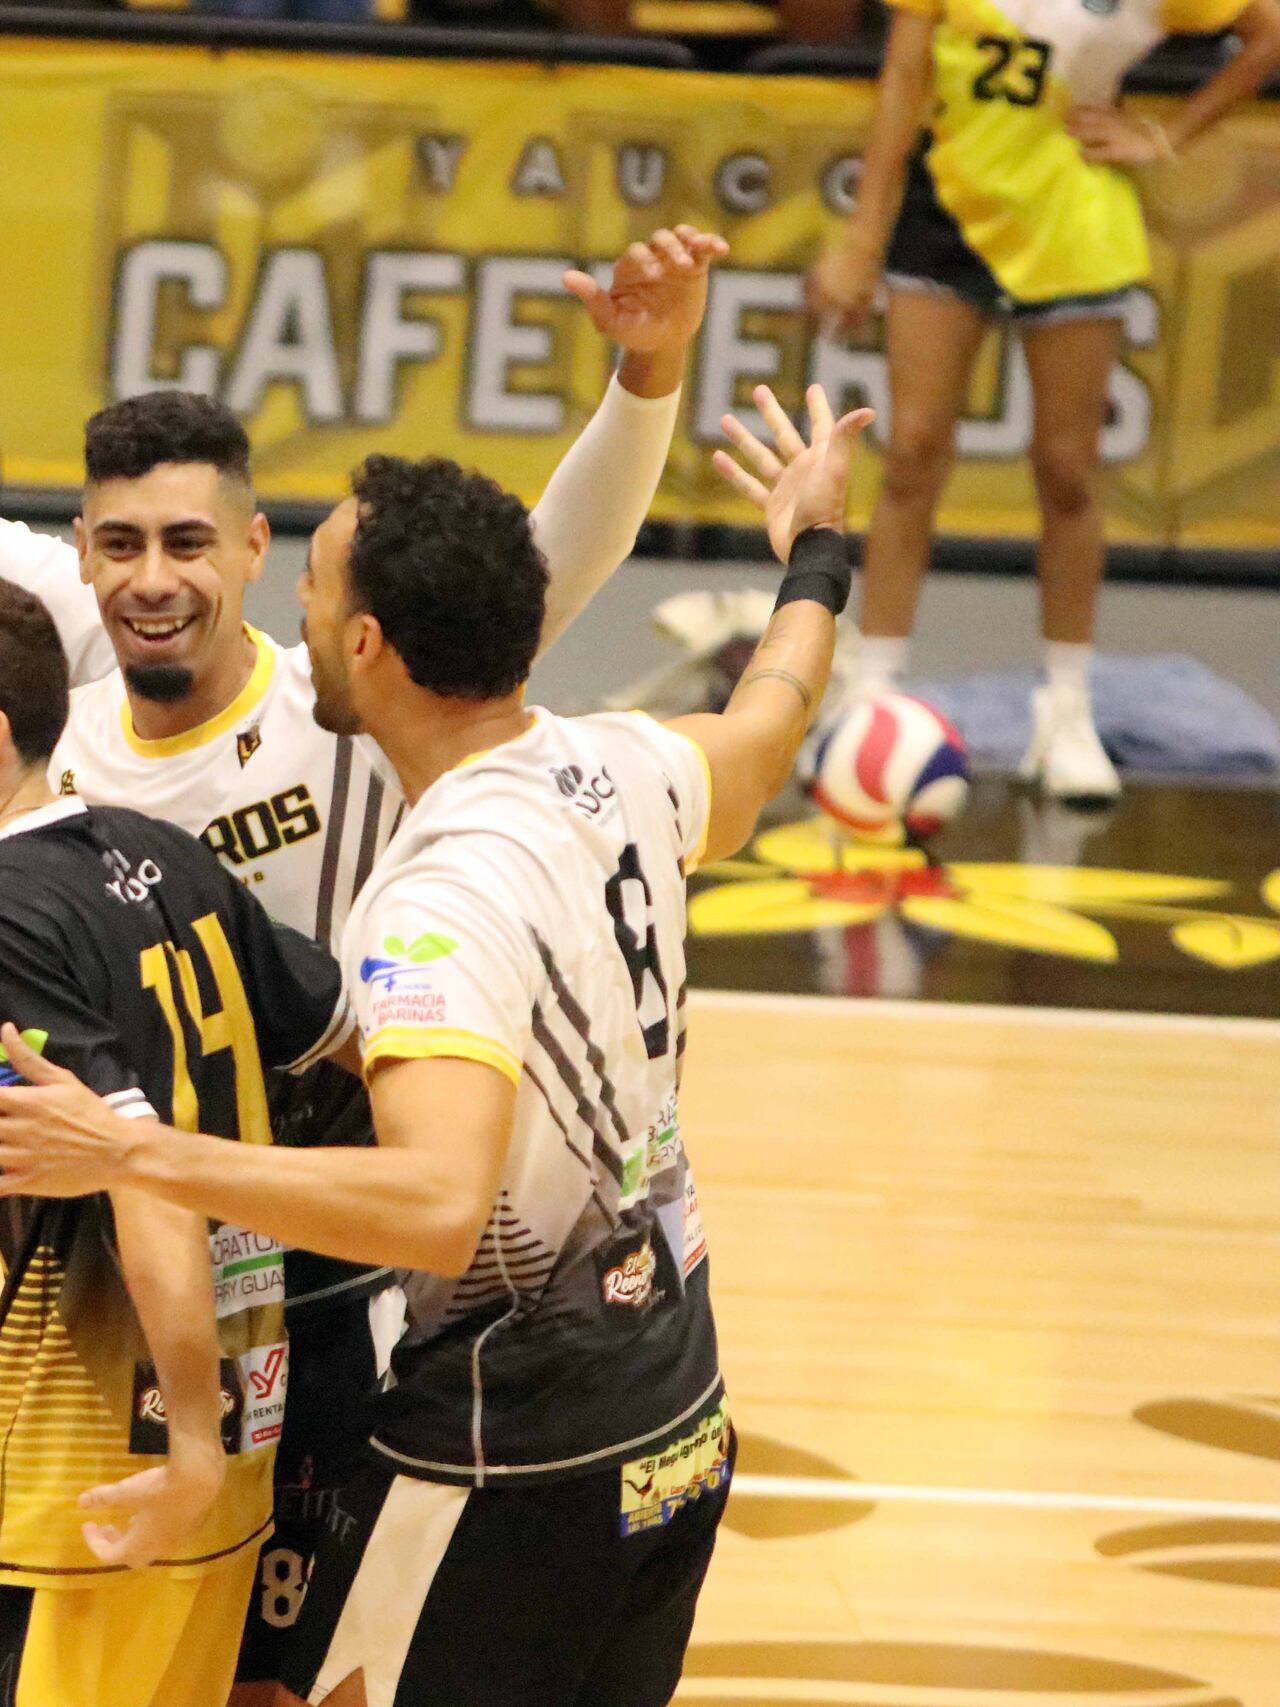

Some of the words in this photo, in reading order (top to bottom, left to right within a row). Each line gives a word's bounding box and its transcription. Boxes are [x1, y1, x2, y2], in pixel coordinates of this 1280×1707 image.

[973, 34, 1053, 107] 23
[372, 992, 447, 1013] FARMACIA
[377, 1007, 447, 1026] BARINAS
[139, 911, 274, 1145] 14
